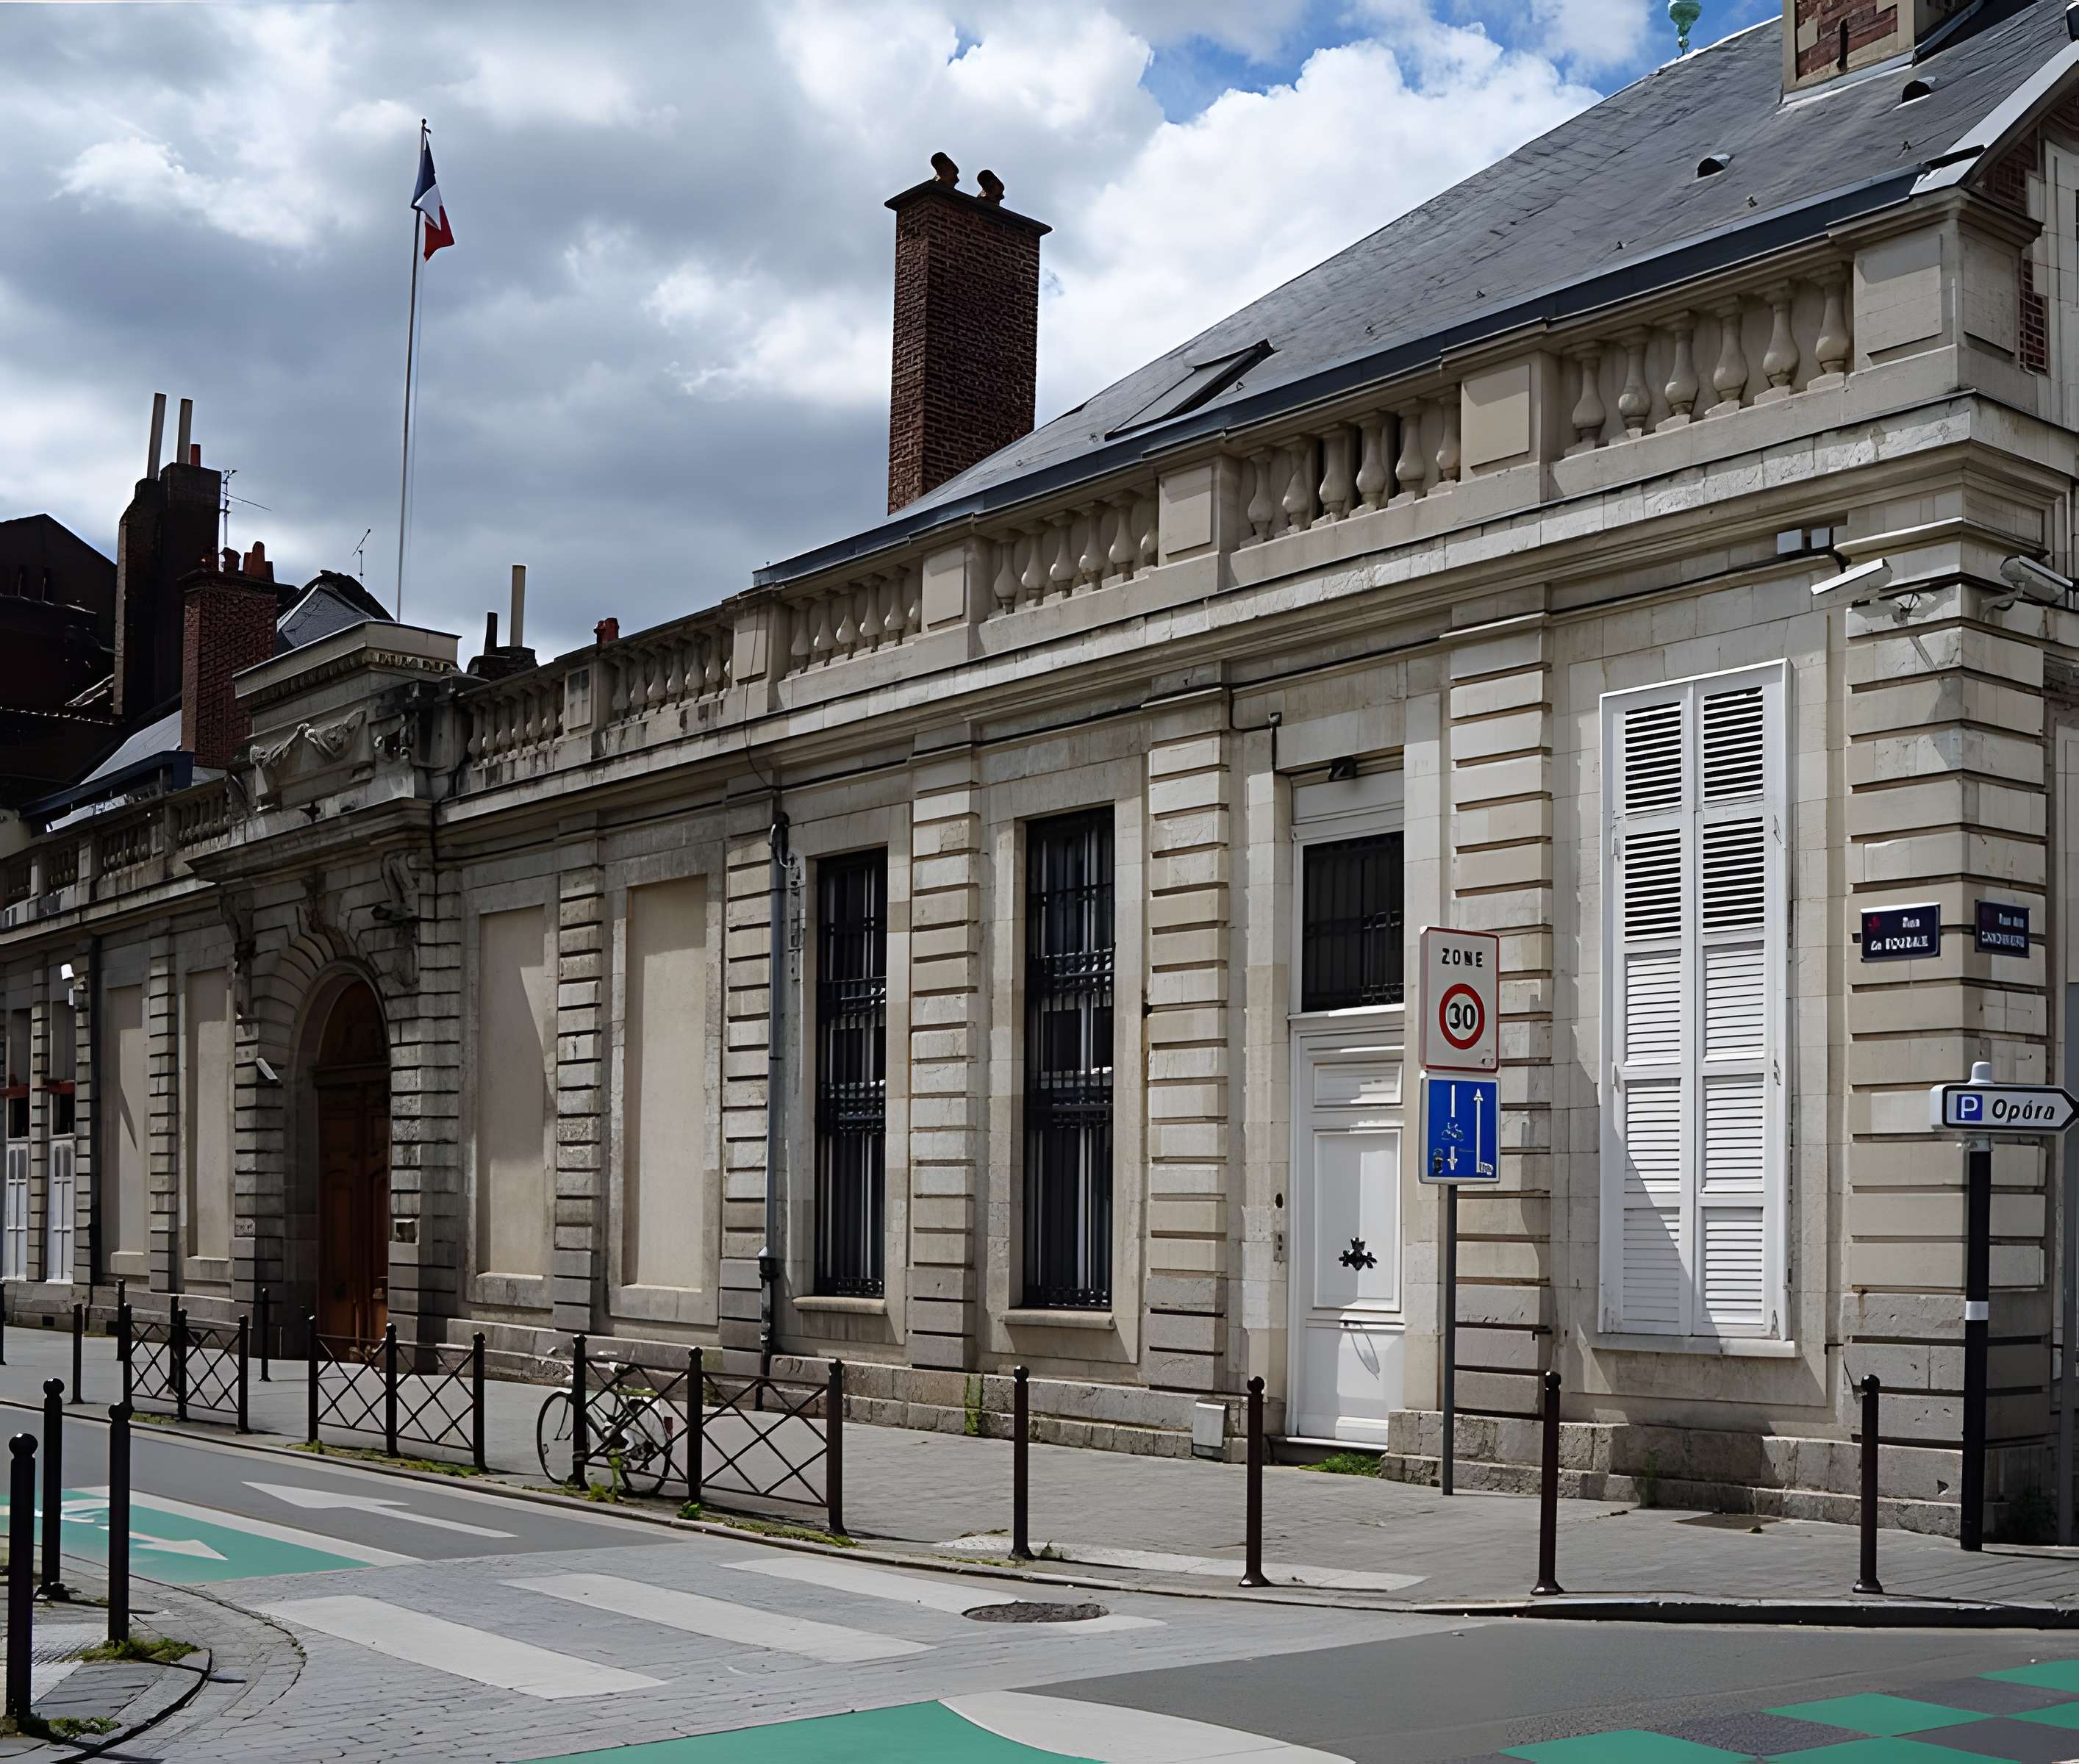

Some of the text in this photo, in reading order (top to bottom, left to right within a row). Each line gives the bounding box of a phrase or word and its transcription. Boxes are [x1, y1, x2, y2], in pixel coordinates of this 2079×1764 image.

[1441, 947, 1483, 968] ZONE
[1448, 1002, 1476, 1030] 30
[1961, 1096, 1979, 1119] P
